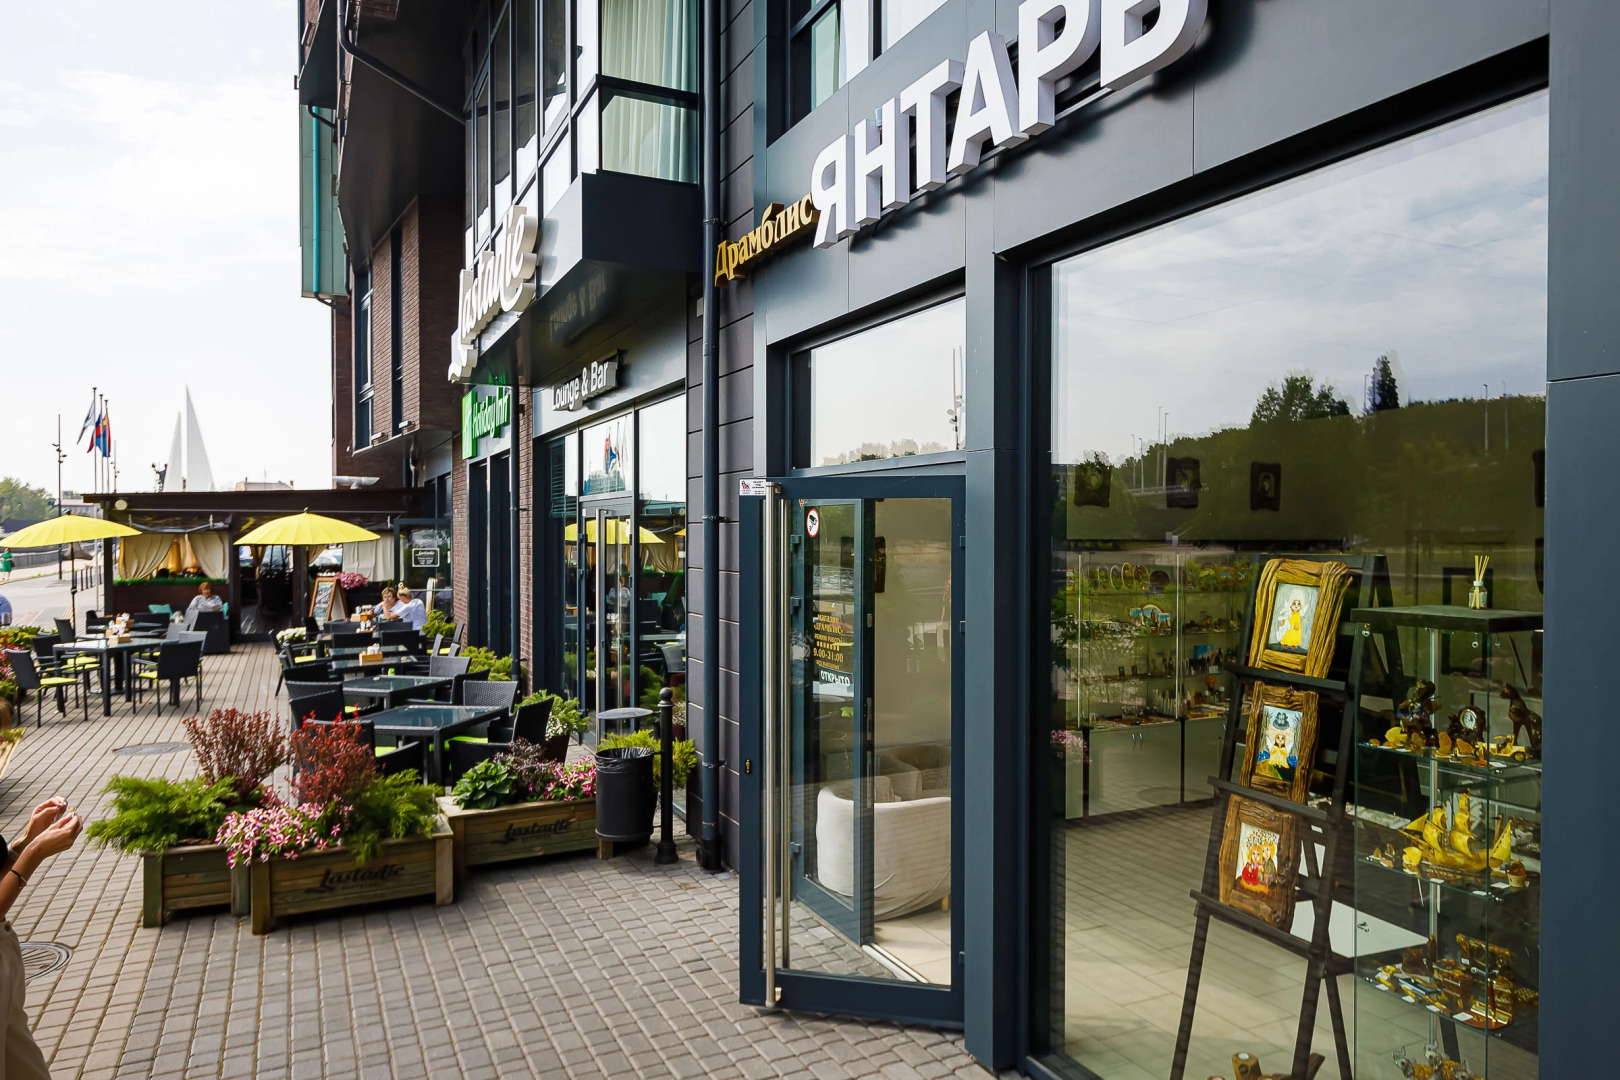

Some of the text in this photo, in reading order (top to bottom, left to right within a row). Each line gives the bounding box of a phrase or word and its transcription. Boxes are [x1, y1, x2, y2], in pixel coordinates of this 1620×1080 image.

[714, 192, 816, 287] Драмблис
[551, 360, 614, 411] Lounge & Bar
[820, 670, 850, 687] ОТКРЫТО
